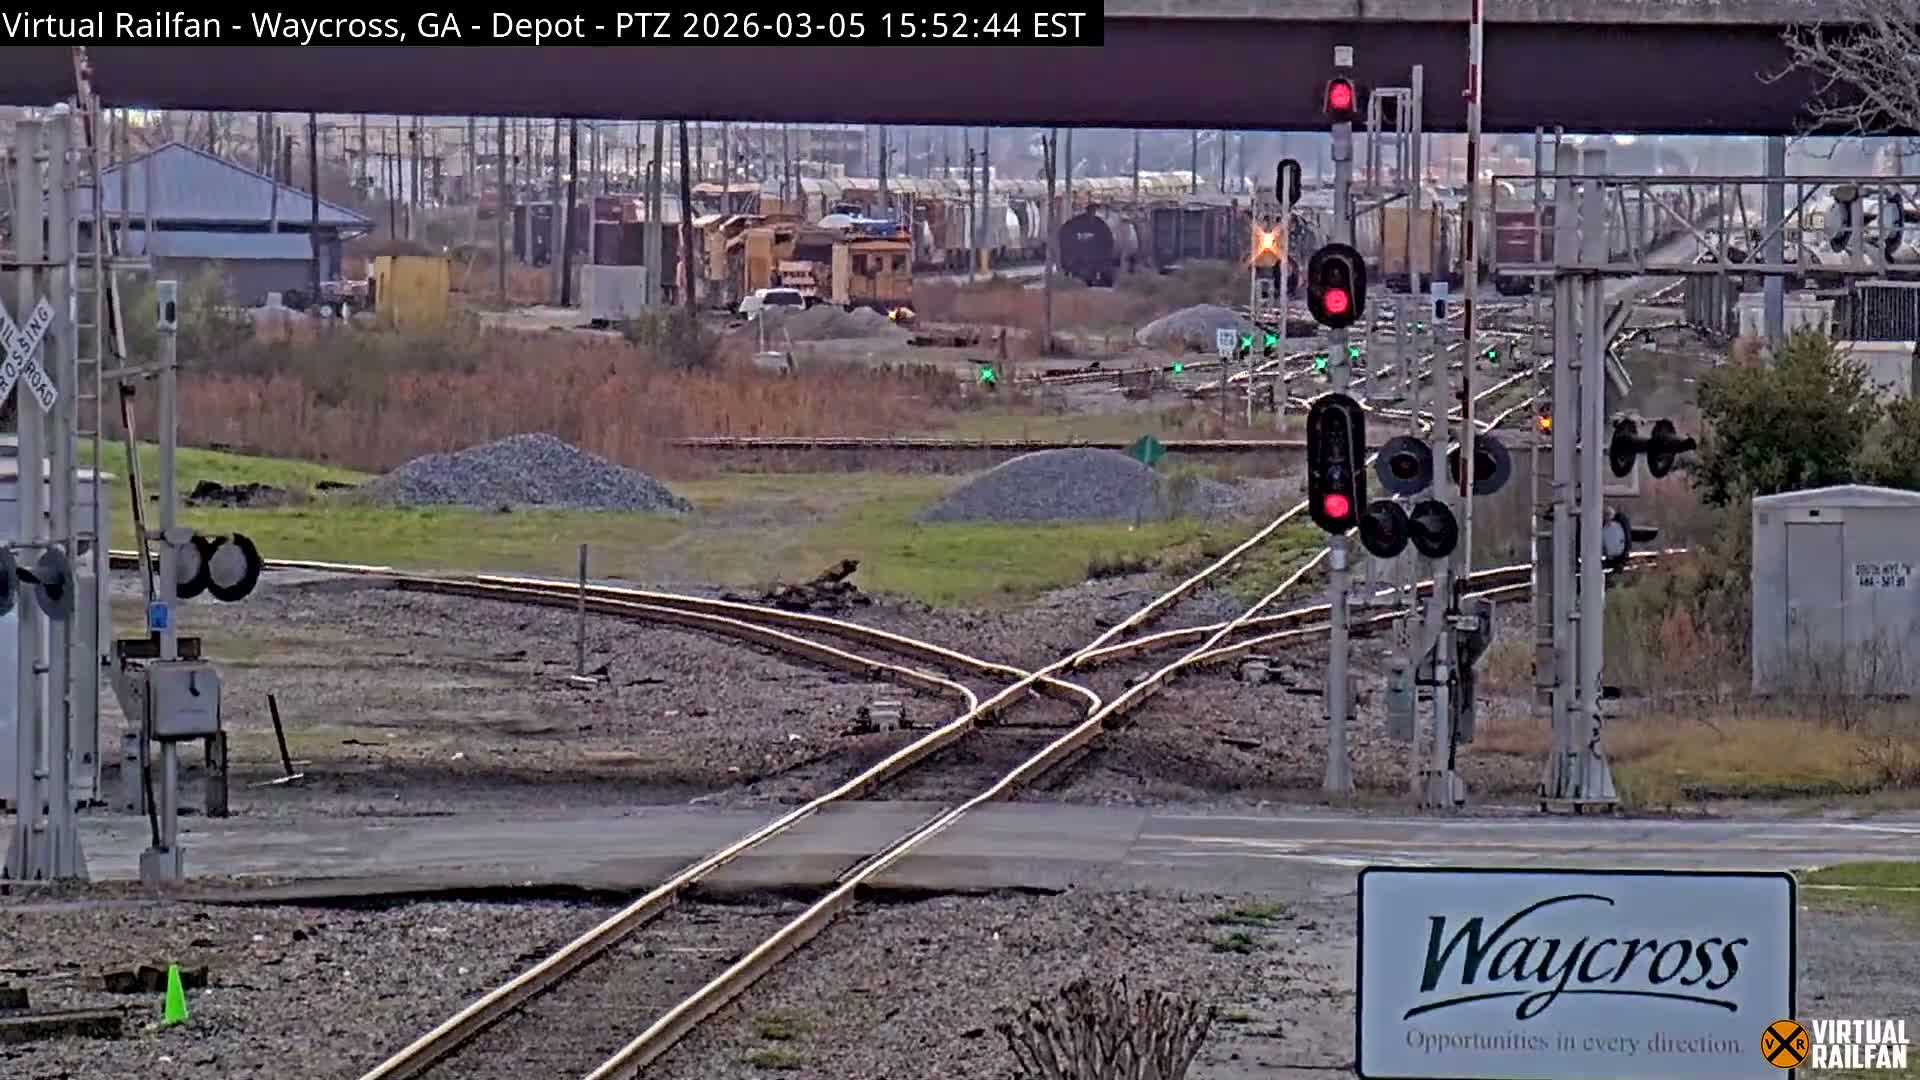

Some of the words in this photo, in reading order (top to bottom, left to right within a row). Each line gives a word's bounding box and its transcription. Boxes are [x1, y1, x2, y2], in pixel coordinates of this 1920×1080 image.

[0, 305, 48, 393] ROSSING
[24, 360, 55, 406] ROAD
[1419, 894, 1749, 1020] Waycross
[1406, 1029, 1550, 1053] Opportunities
[1556, 1031, 1576, 1050] in
[1583, 1036, 1640, 1057] every
[1648, 1031, 1745, 1055] direction.
